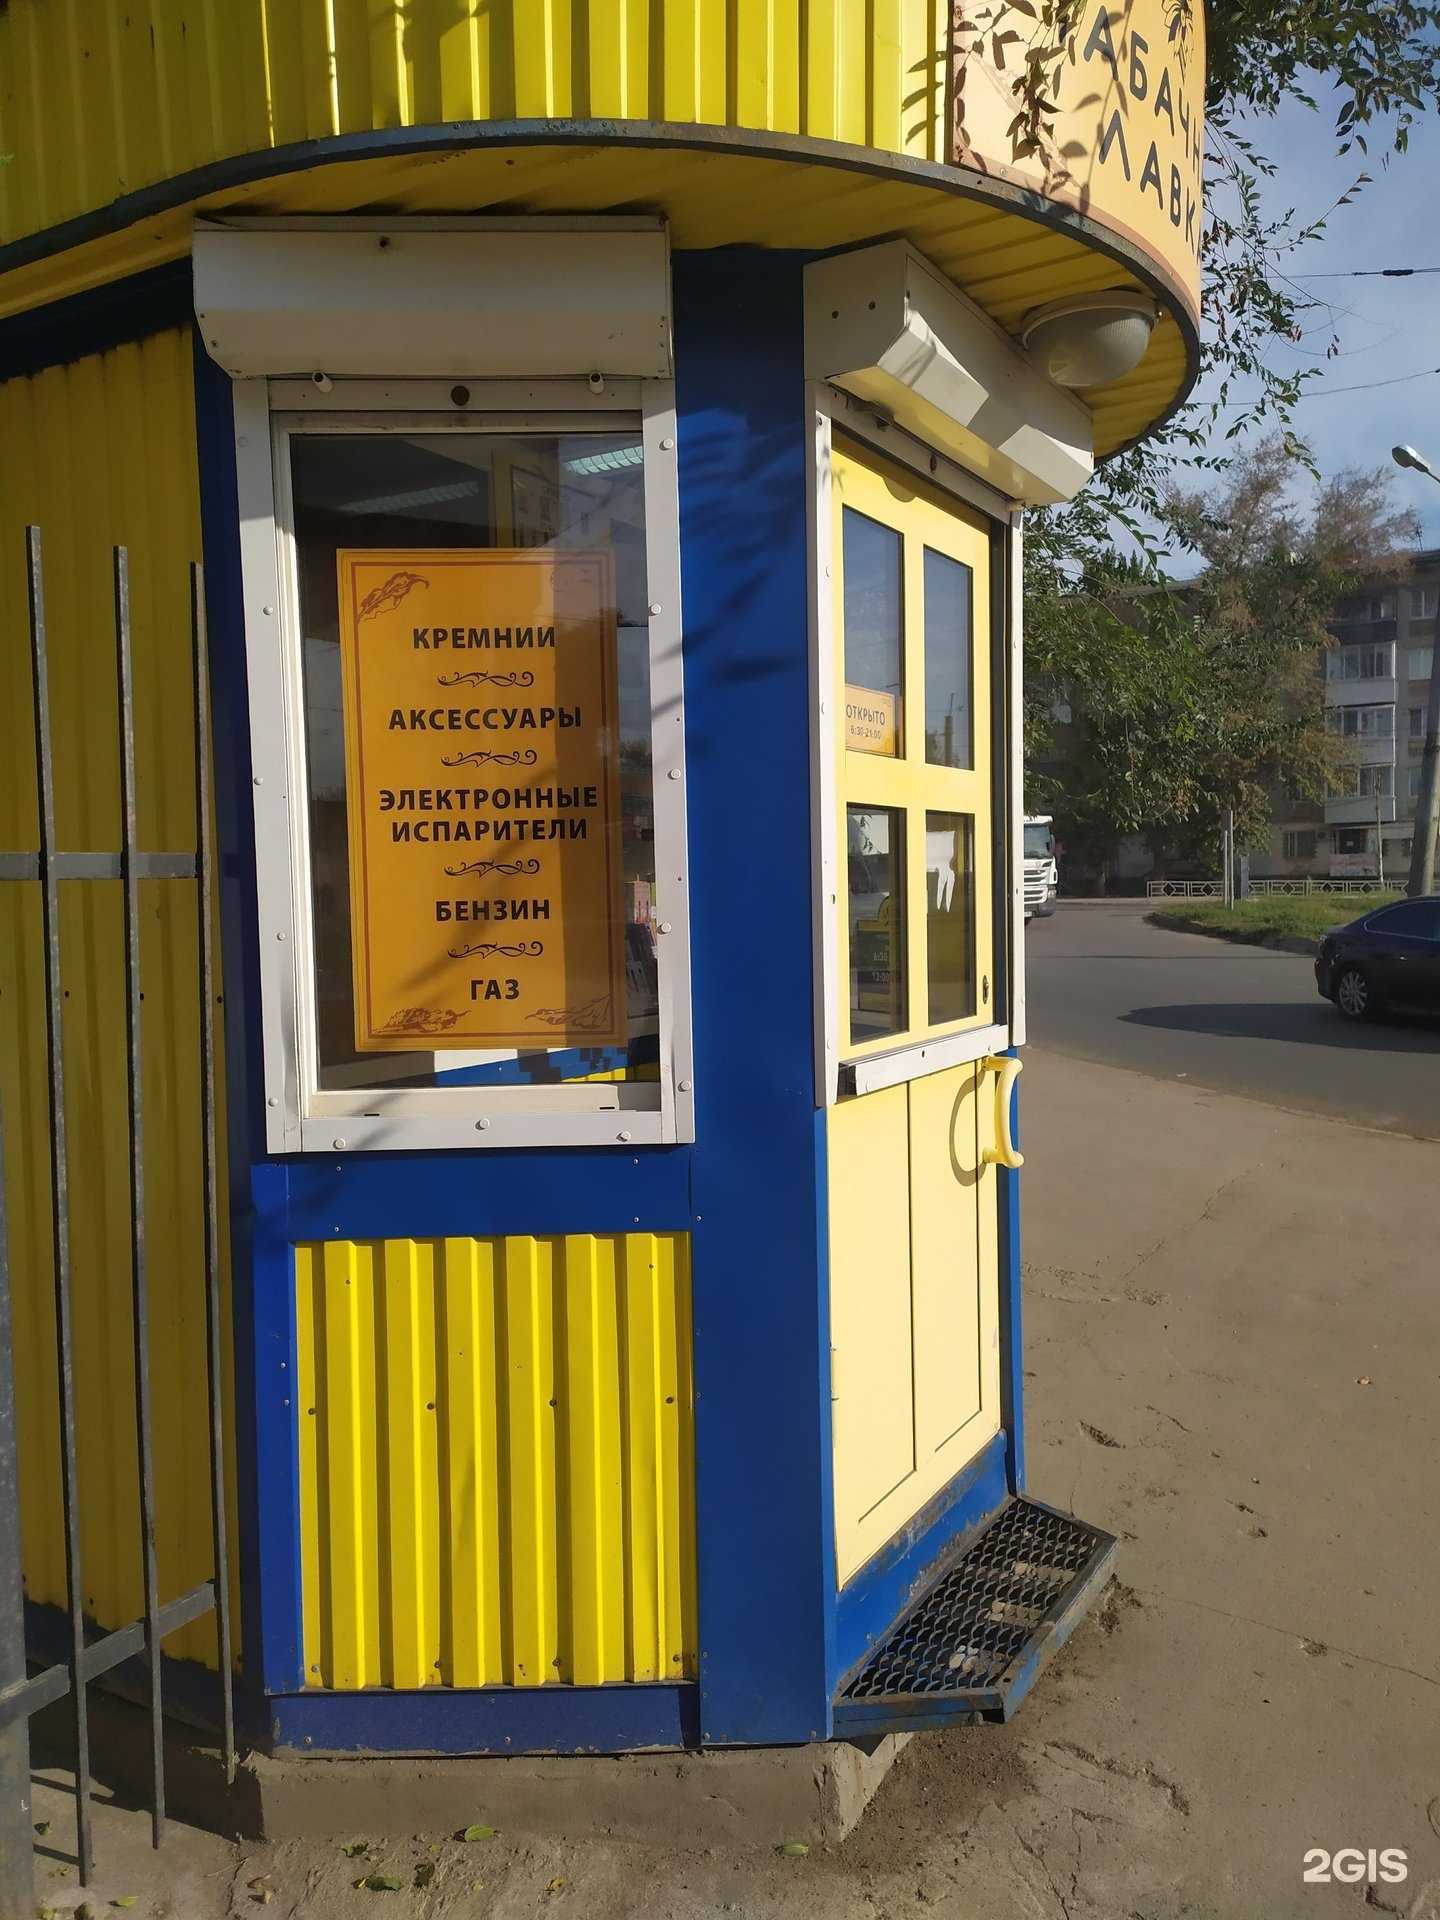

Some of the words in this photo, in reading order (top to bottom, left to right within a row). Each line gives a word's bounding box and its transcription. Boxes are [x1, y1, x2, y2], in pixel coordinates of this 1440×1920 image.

[412, 626, 556, 650] КРЕМНИИ
[388, 705, 582, 731] АКСЕССУАРЫ
[845, 703, 886, 726] ОТКРЫТО
[379, 786, 598, 811] ЭЛЕКТРОННЫЕ
[391, 818, 588, 843] ИСПАРИТЕЛИ
[435, 899, 551, 922] БЕНЗИН
[470, 979, 520, 1001] ГАЗ
